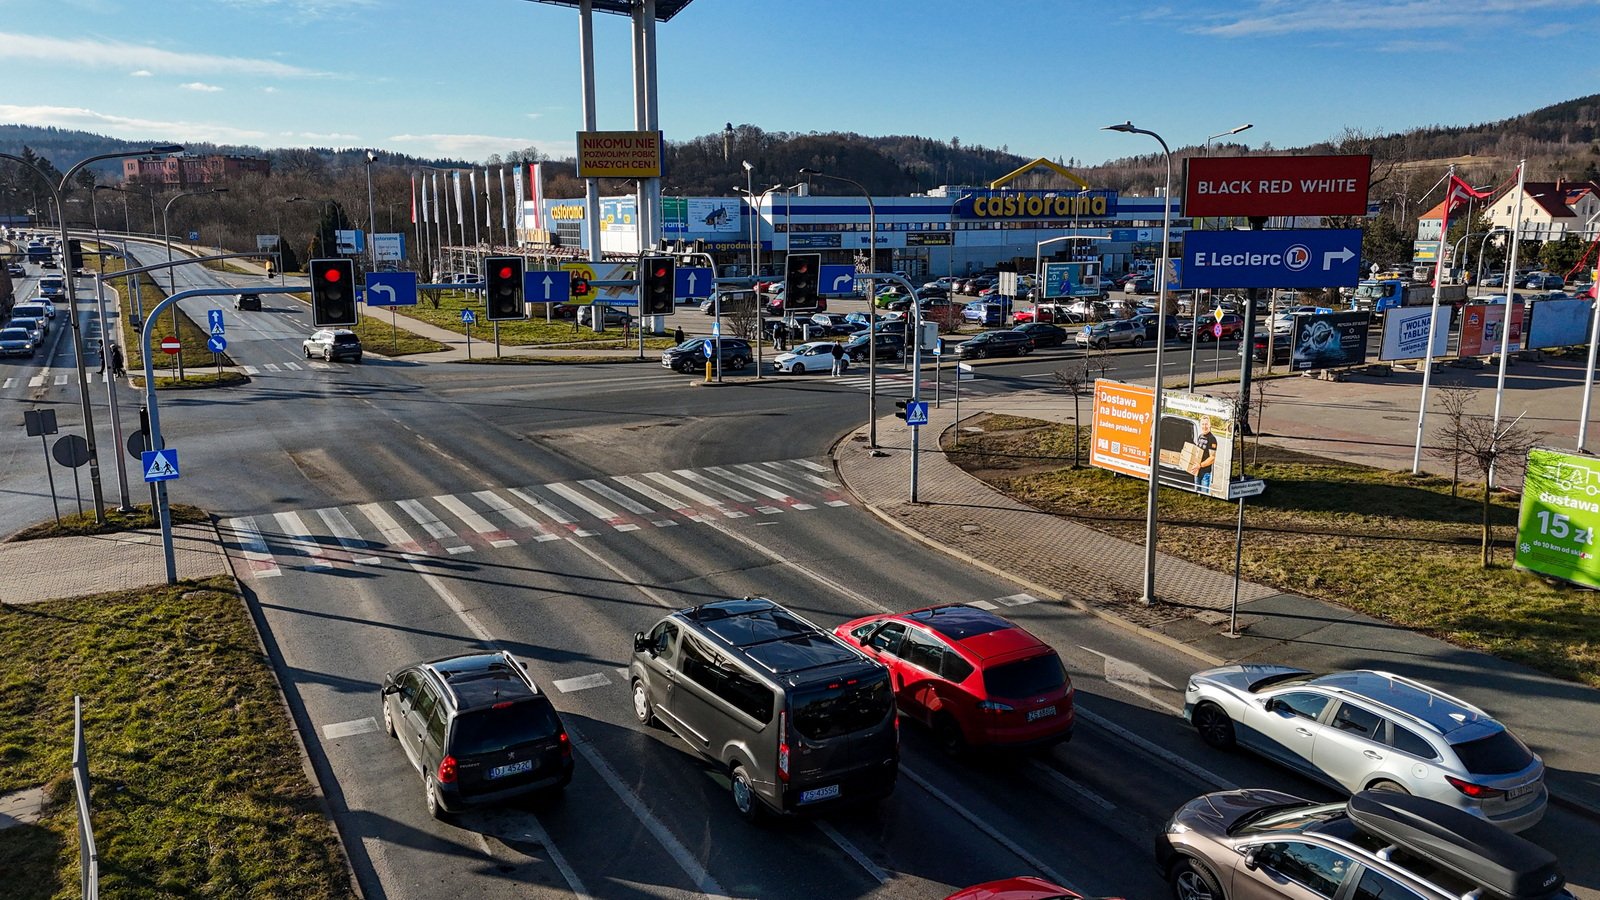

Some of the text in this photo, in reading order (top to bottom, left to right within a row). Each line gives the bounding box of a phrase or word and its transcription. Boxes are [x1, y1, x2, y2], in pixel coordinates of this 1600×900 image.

[584, 138, 655, 149] NIKOMU NIE
[1198, 179, 1357, 194] BLACK RED WHITE
[973, 192, 1107, 216] castorama
[551, 204, 584, 220] castorama
[1194, 252, 1282, 266] E.Leclerc
[1406, 318, 1431, 330] WOLNA
[1403, 327, 1429, 340] TABLIC
[1100, 392, 1136, 408] Dostawa
[1100, 406, 1150, 424] na budowę?
[1099, 420, 1115, 429] żaden
[1115, 424, 1138, 434] problem
[1540, 491, 1599, 513] dostawa
[1537, 510, 1593, 545] 15 zł
[1550, 544, 1560, 552] km
[1561, 546, 1570, 554] od
[1571, 548, 1593, 560] sklpu
[805, 791, 814, 800] ZS
